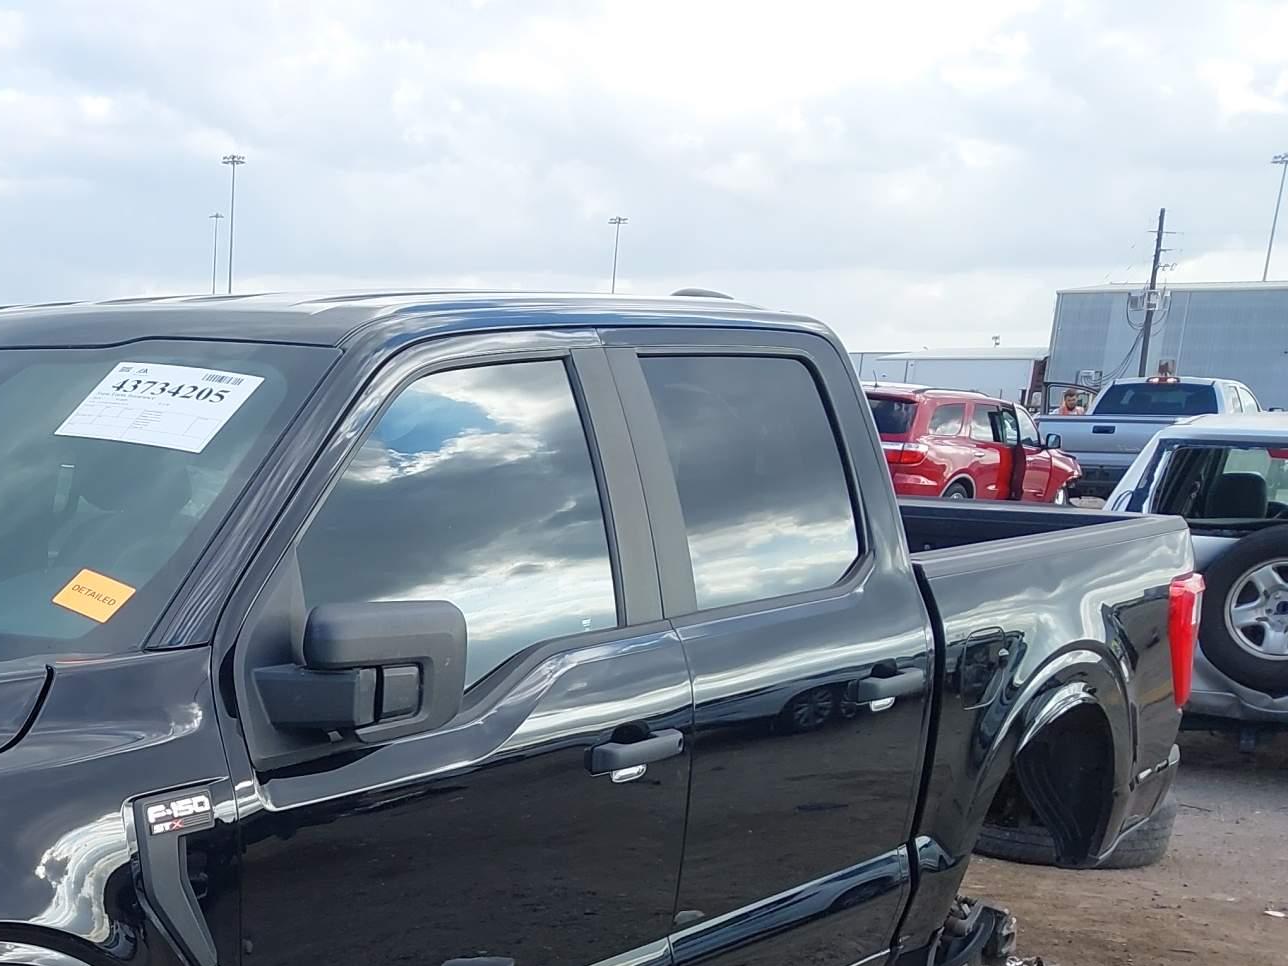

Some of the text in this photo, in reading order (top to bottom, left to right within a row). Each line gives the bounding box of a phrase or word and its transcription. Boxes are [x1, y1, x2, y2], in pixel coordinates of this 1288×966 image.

[112, 378, 231, 403] 43734205
[71, 584, 117, 607] DETAILED
[147, 795, 211, 823] F-150
